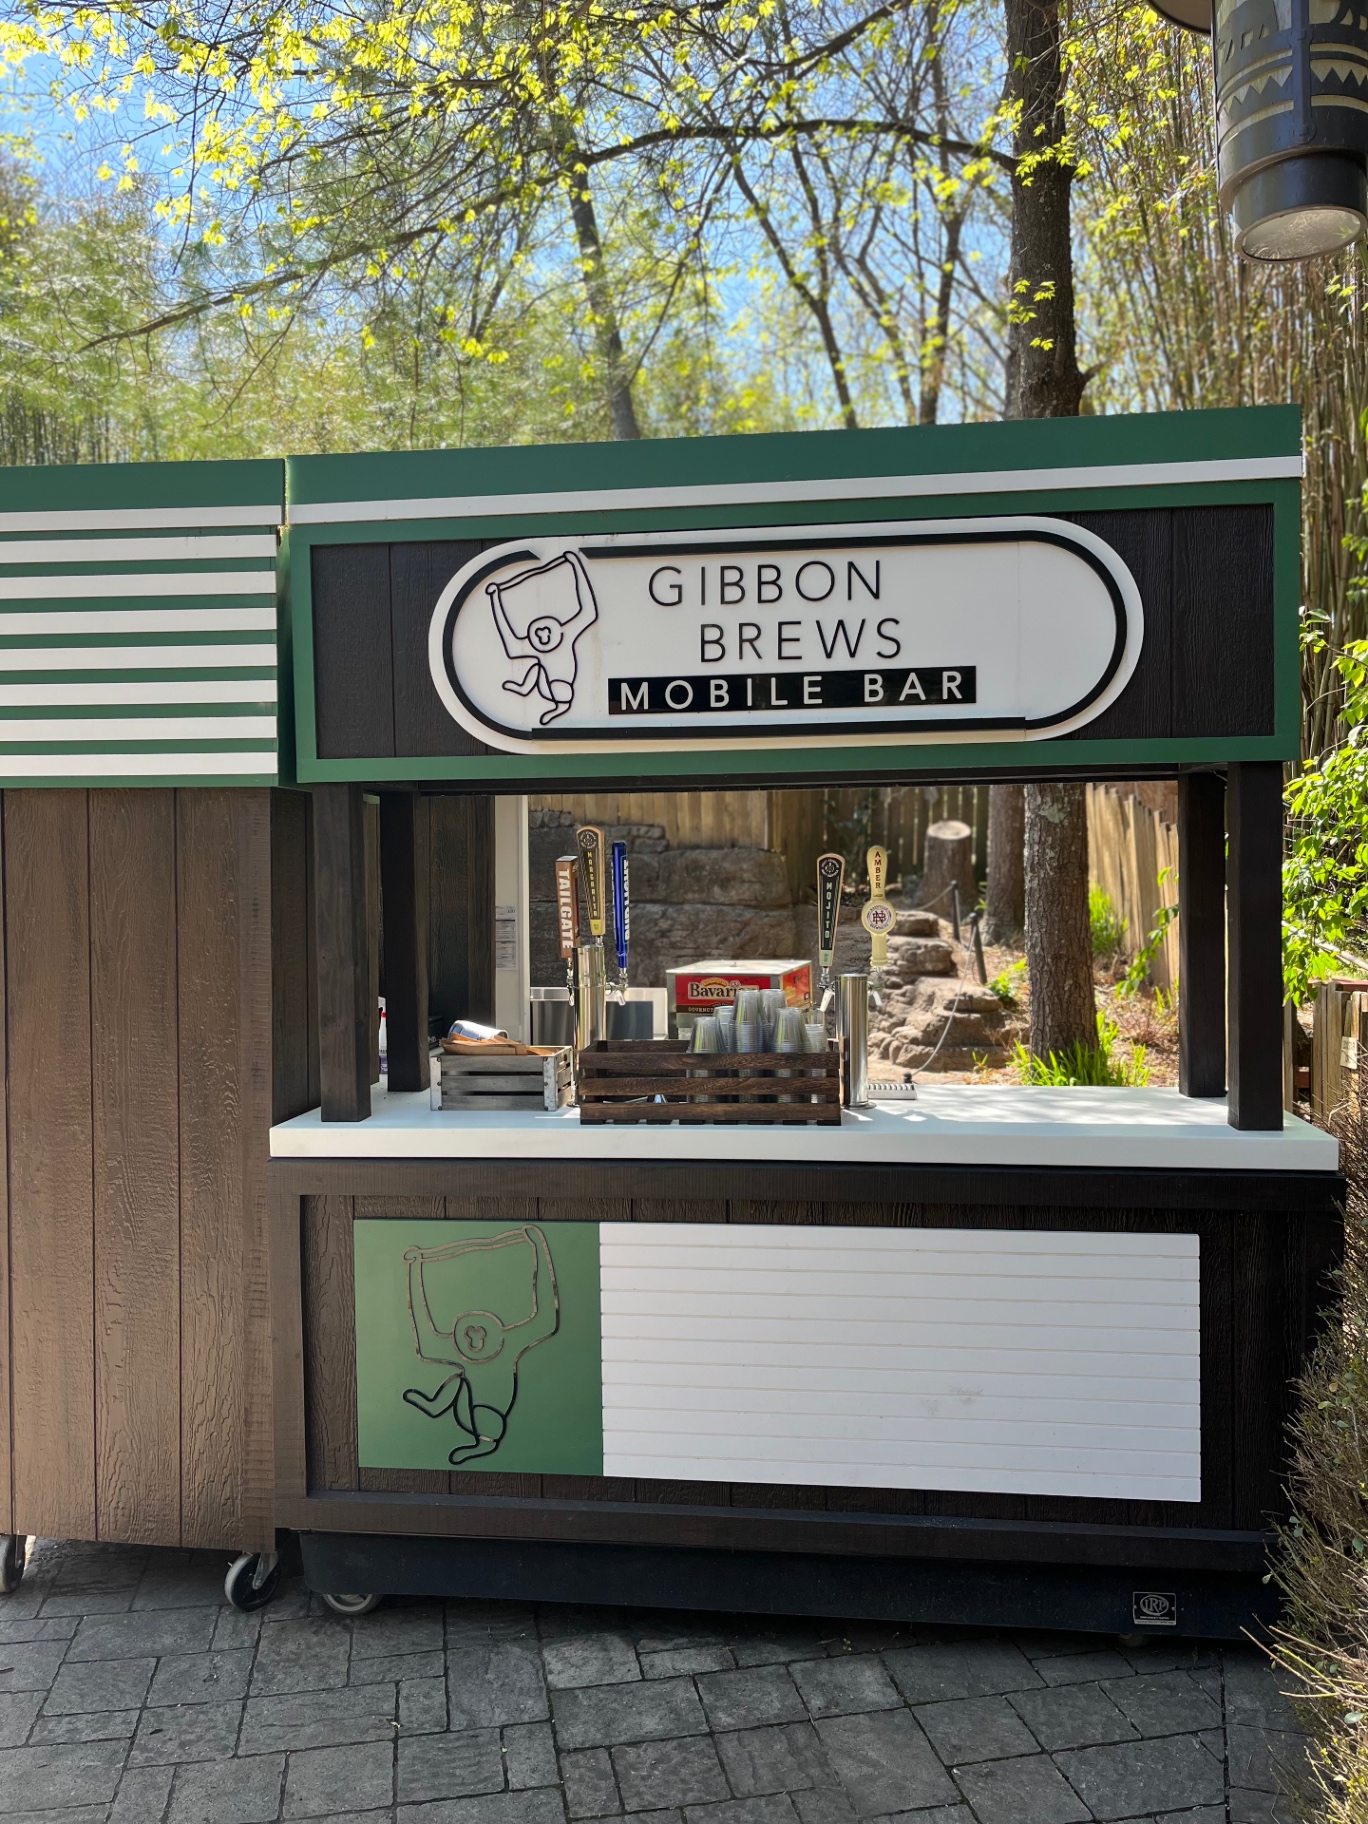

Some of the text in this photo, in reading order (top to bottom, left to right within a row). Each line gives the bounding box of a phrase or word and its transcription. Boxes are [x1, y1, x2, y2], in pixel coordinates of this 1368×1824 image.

[648, 560, 881, 606] GIBBON
[700, 617, 902, 663] BREWS
[620, 670, 963, 711] MOBILE BAR
[587, 851, 598, 917] MARGARITA
[874, 851, 882, 889] AMBER
[558, 868, 574, 949] TAILGATE
[824, 882, 833, 938] MOJITO
[691, 983, 756, 998] Bavari
